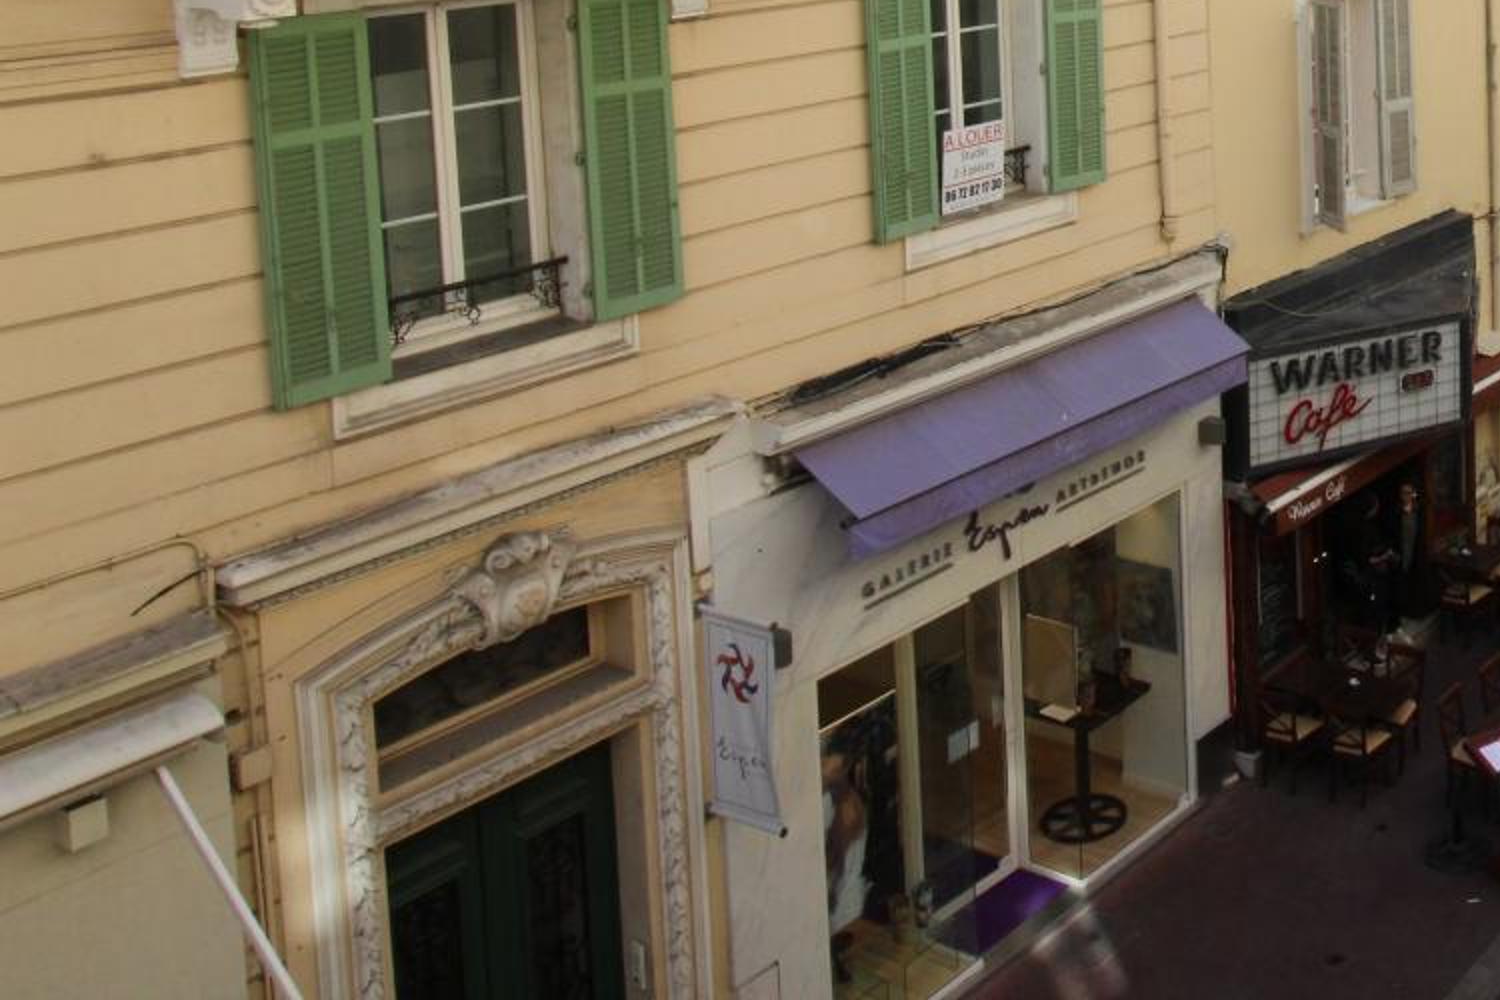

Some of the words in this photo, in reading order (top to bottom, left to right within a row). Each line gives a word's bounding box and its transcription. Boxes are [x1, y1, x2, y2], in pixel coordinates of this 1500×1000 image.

[955, 122, 1004, 147] LOUER
[1270, 330, 1442, 395] WARNER
[1284, 382, 1374, 455] Café
[861, 542, 953, 598] GALERIE
